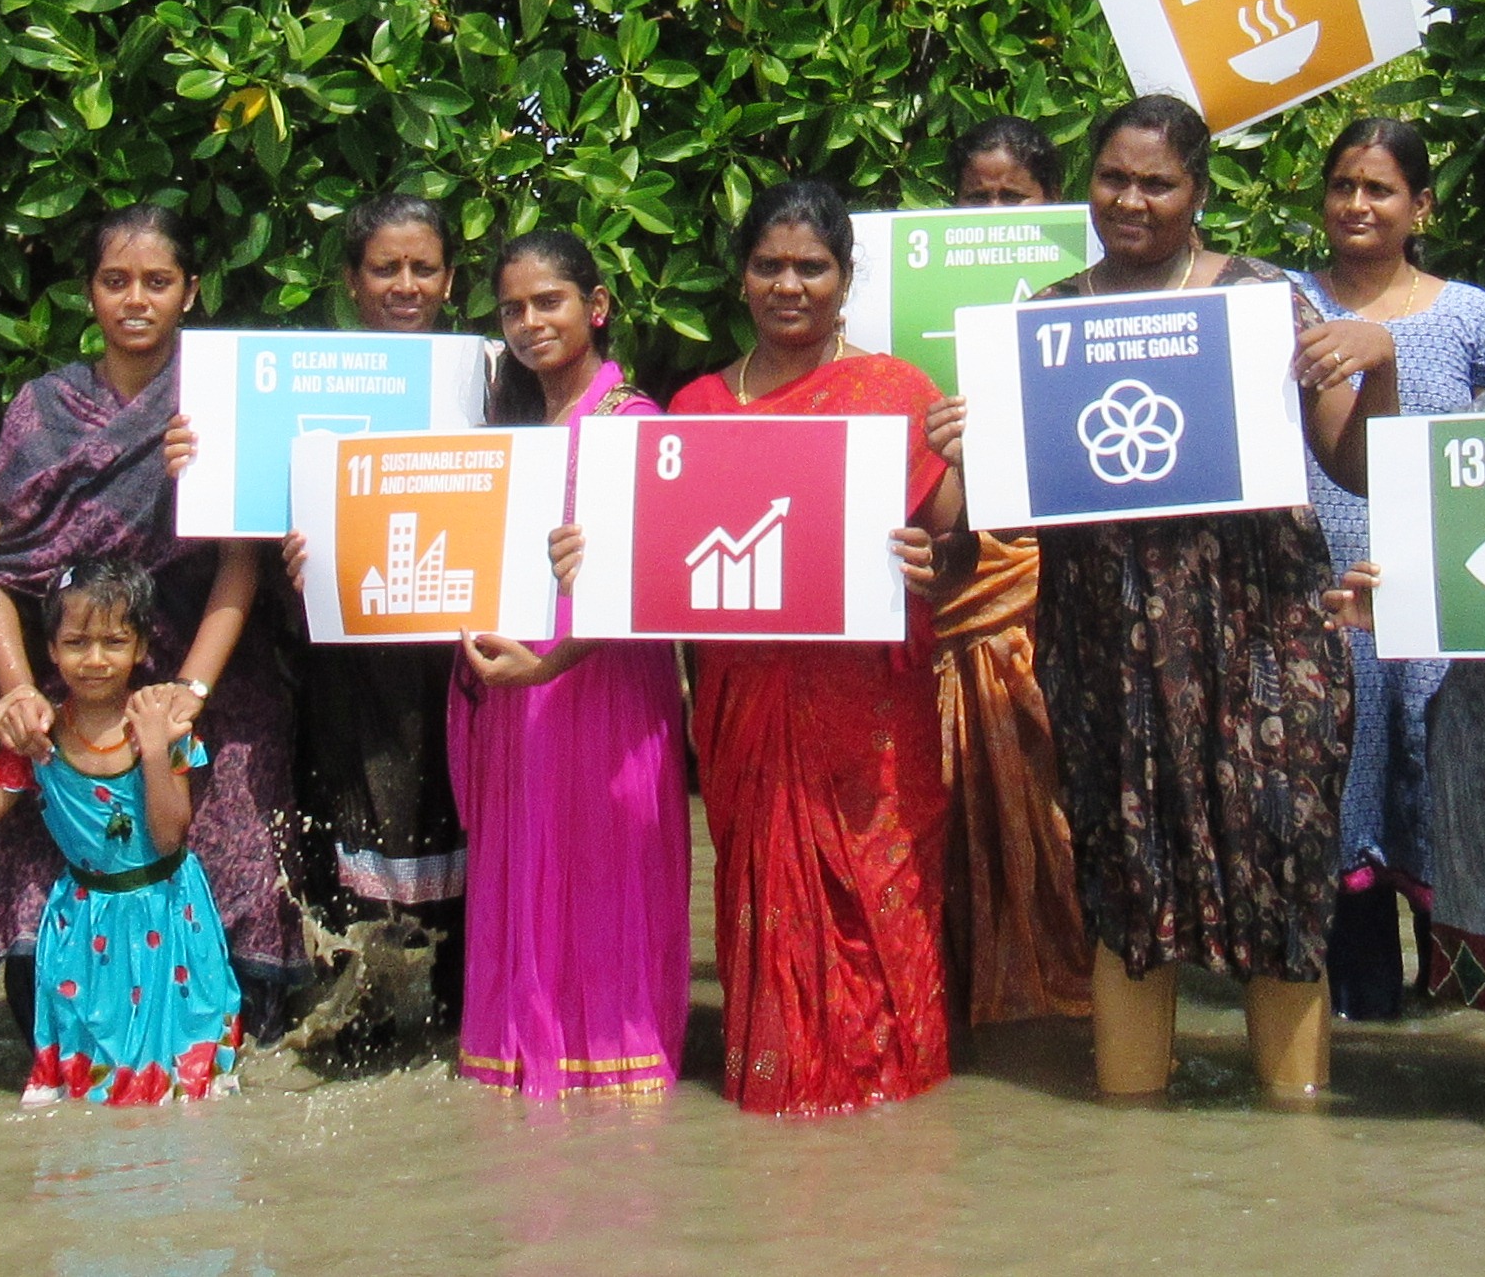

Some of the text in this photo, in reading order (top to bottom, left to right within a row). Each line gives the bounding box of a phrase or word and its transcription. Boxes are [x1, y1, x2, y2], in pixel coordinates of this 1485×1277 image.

[945, 224, 1041, 245] GOOD HEALTH
[907, 229, 929, 269] 3
[944, 245, 1059, 267] AND WELL-BEING
[1084, 312, 1199, 340] PARTNERSHIPS
[1036, 322, 1072, 368] 17
[1086, 335, 1199, 364] FOR THE GOALS
[254, 351, 277, 393] 6
[292, 351, 388, 370] CLEAN WATER
[292, 376, 406, 395] AND SANITATION
[380, 450, 505, 473] SUSTAINABLE CITIES
[656, 435, 682, 480] 8
[1444, 438, 1485, 488] 13
[347, 454, 373, 497] 11
[380, 474, 492, 495] AND COMMUNITIES
